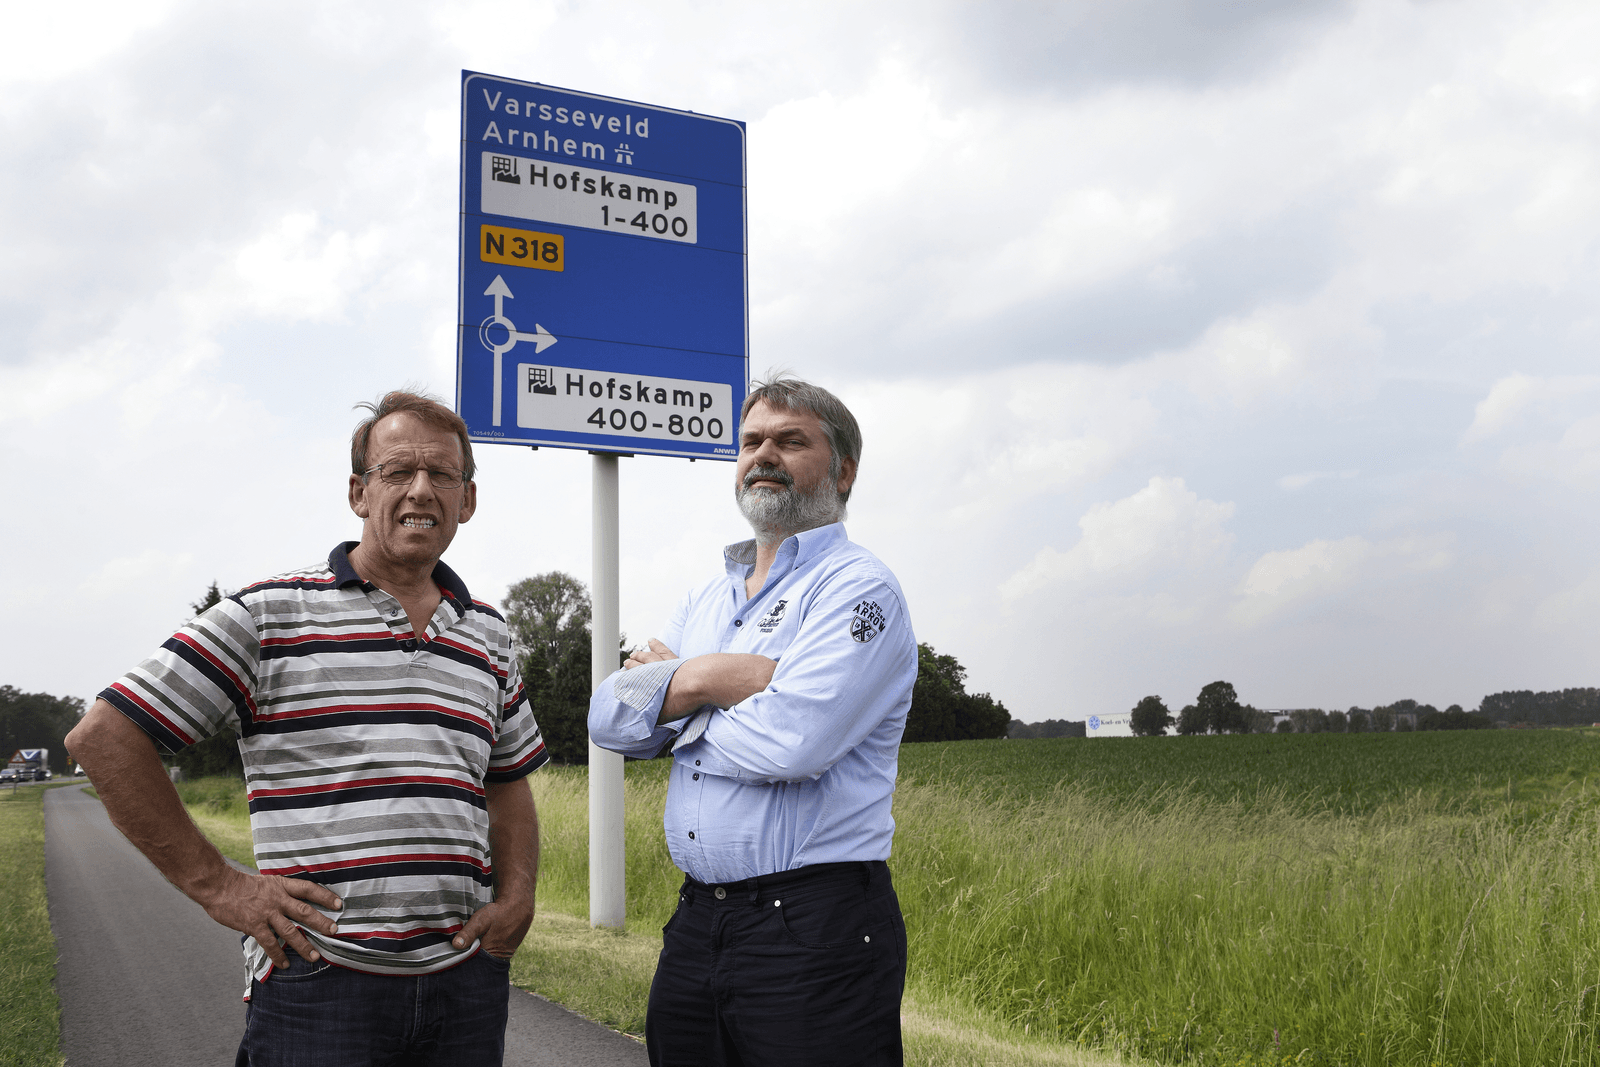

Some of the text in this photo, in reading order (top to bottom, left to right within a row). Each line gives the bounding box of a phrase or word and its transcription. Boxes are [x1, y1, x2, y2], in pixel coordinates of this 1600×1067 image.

[482, 88, 649, 139] Varsseveld
[482, 121, 605, 161] Arnhem
[530, 164, 678, 211] Hofskamp
[601, 205, 688, 238] 1-400
[566, 373, 713, 413] Hofskamp
[587, 407, 724, 439] 400-800
[713, 447, 737, 455] ANWB
[852, 603, 886, 632] ARROW
